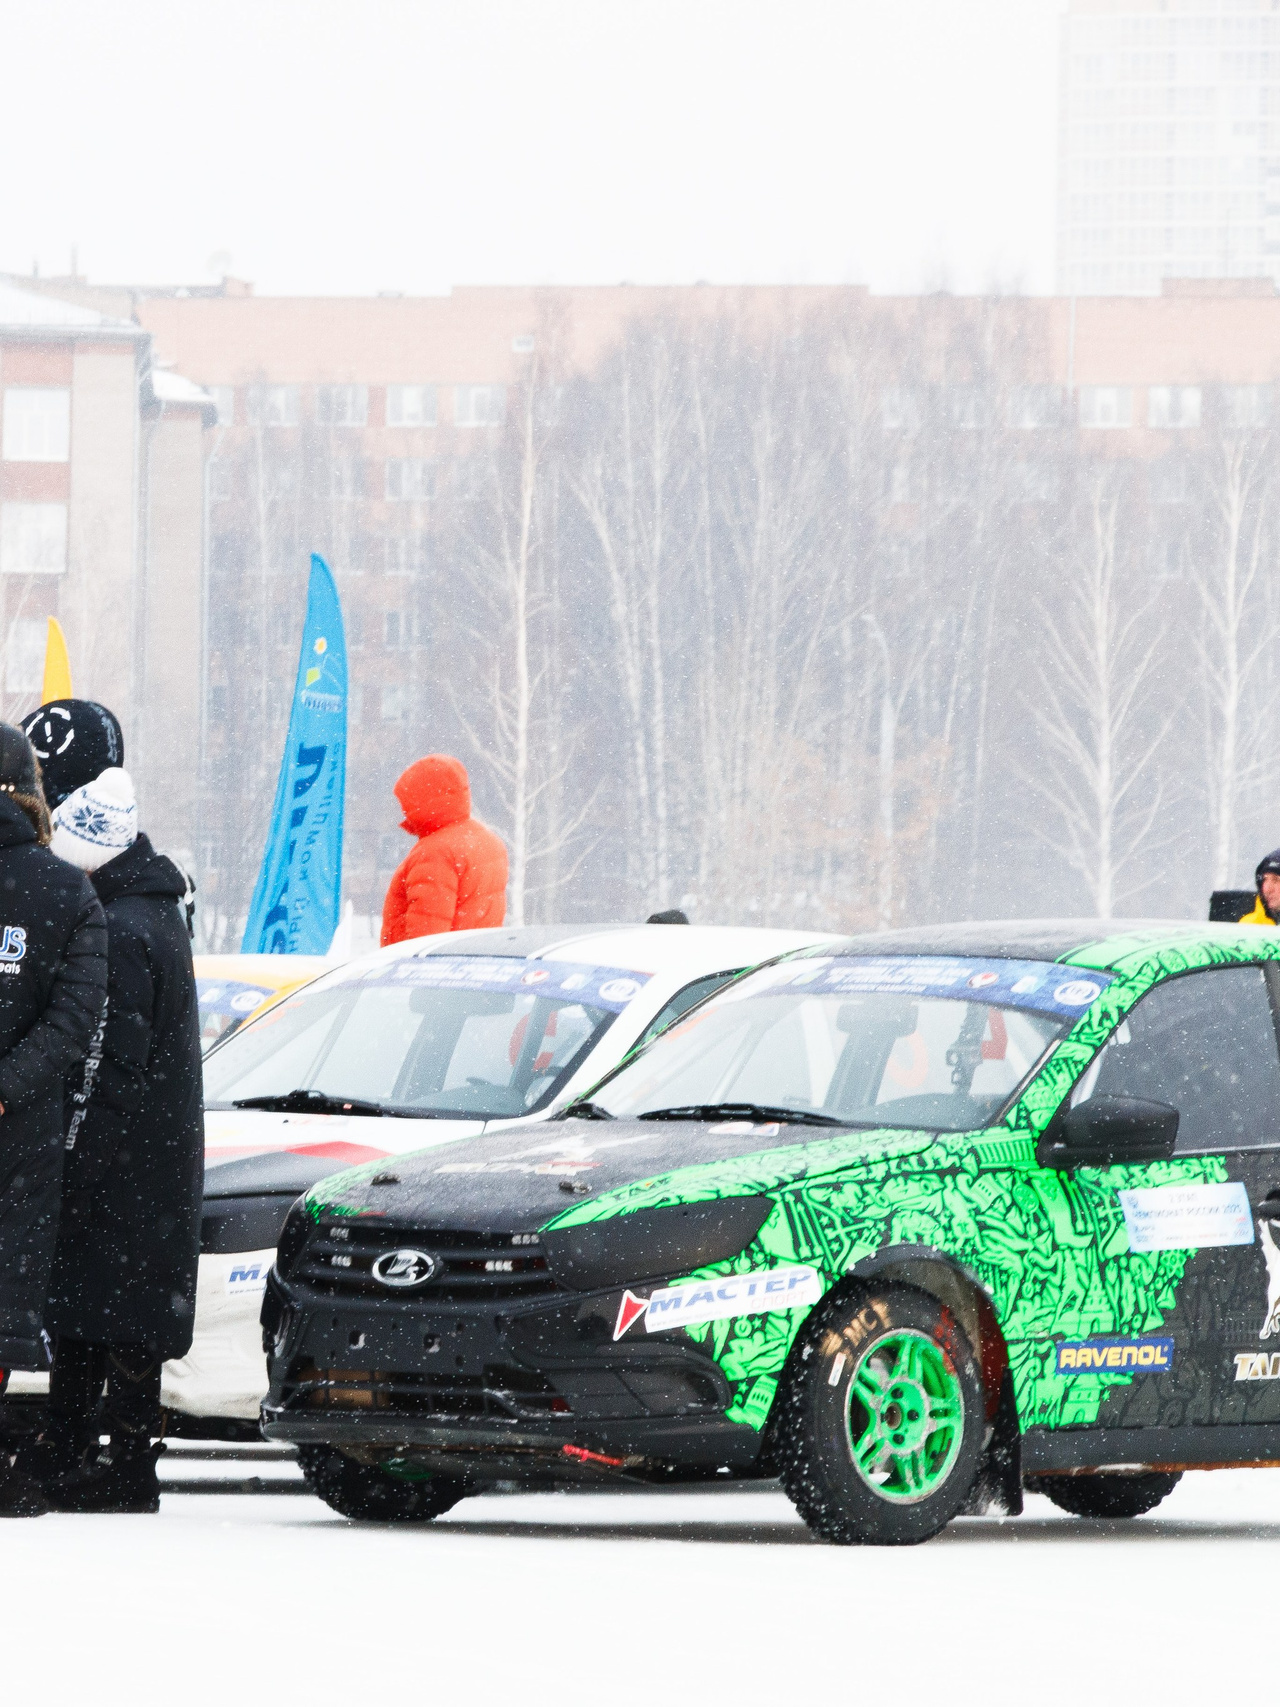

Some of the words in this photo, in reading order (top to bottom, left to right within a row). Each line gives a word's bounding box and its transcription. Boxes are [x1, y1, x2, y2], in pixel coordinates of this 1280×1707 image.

[65, 1108, 87, 1150] Team
[649, 1269, 812, 1315] МАСТЕР
[1059, 1345, 1168, 1368] RAVENOL
